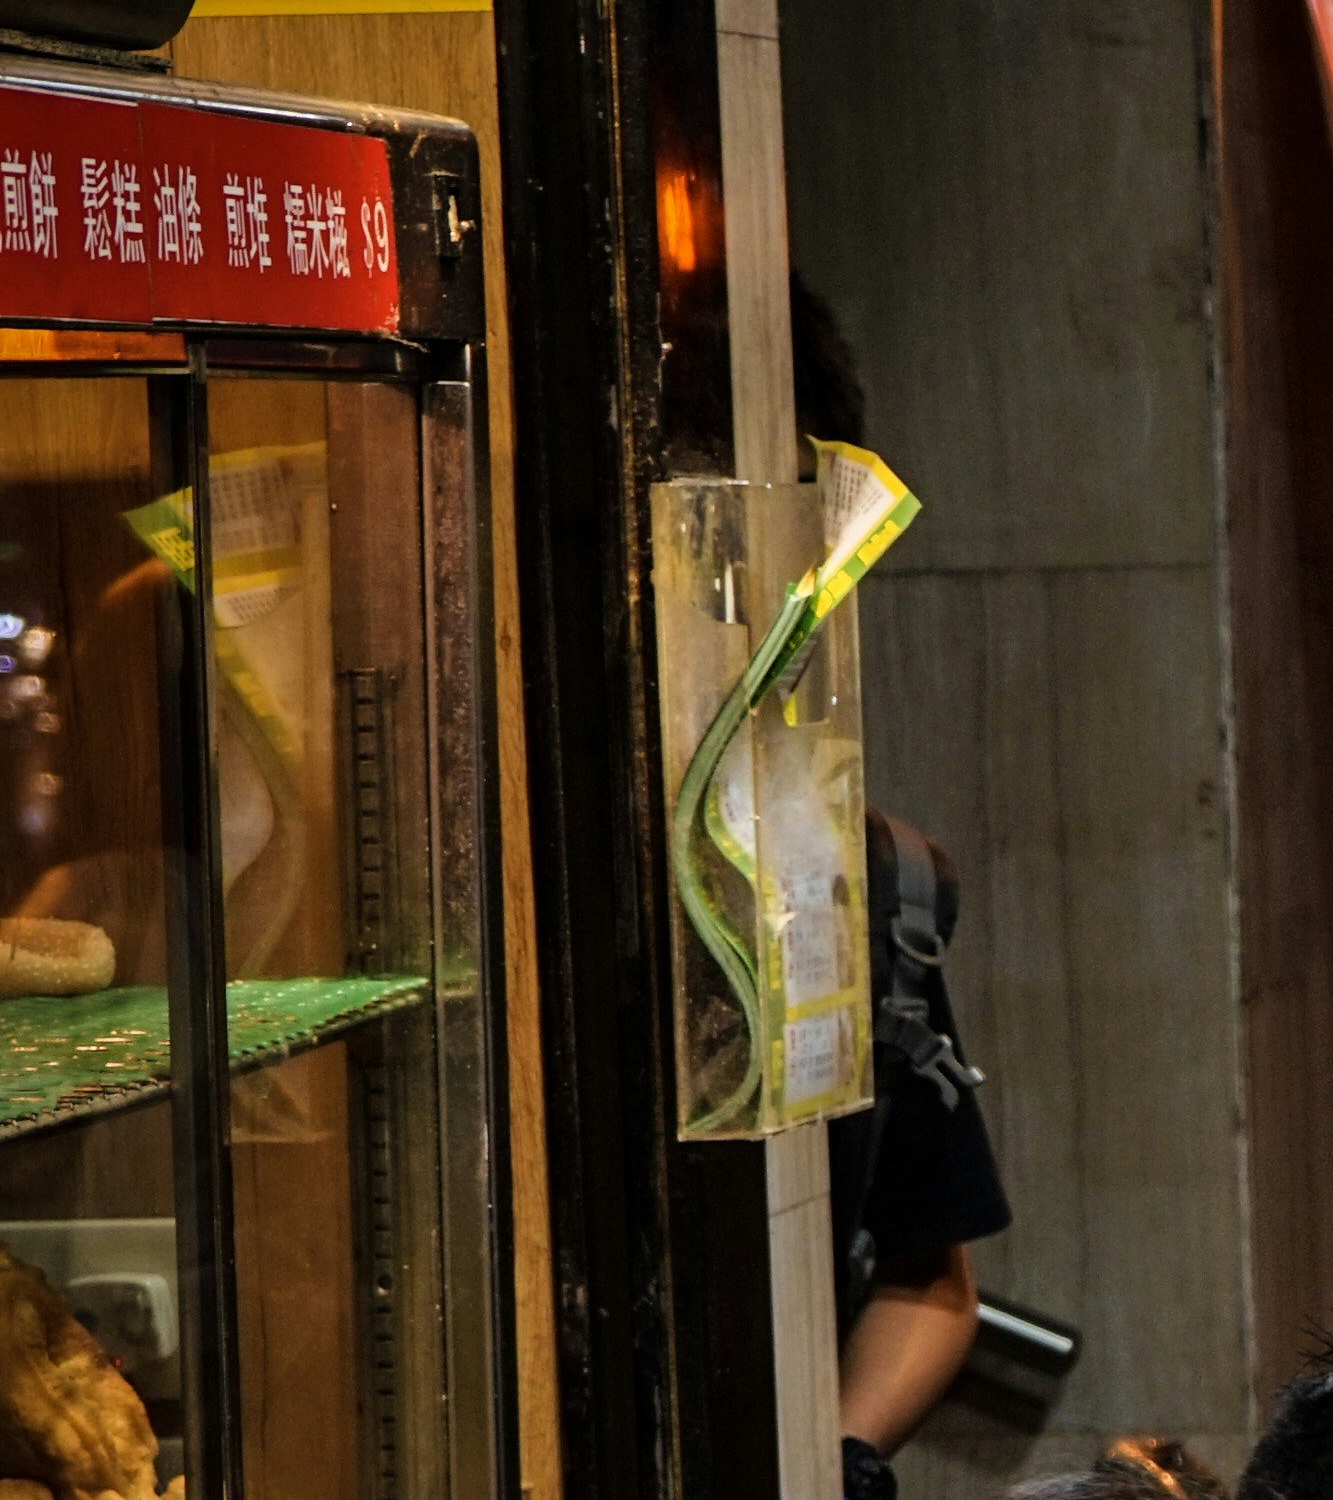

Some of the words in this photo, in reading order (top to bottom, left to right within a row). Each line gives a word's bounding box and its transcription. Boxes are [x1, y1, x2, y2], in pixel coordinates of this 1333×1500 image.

[79, 156, 147, 265] 鬆糕
[152, 162, 205, 267] 油條
[222, 171, 273, 275] 煎堆
[282, 180, 353, 280] 糯米糍
[359, 194, 391, 280] $9
